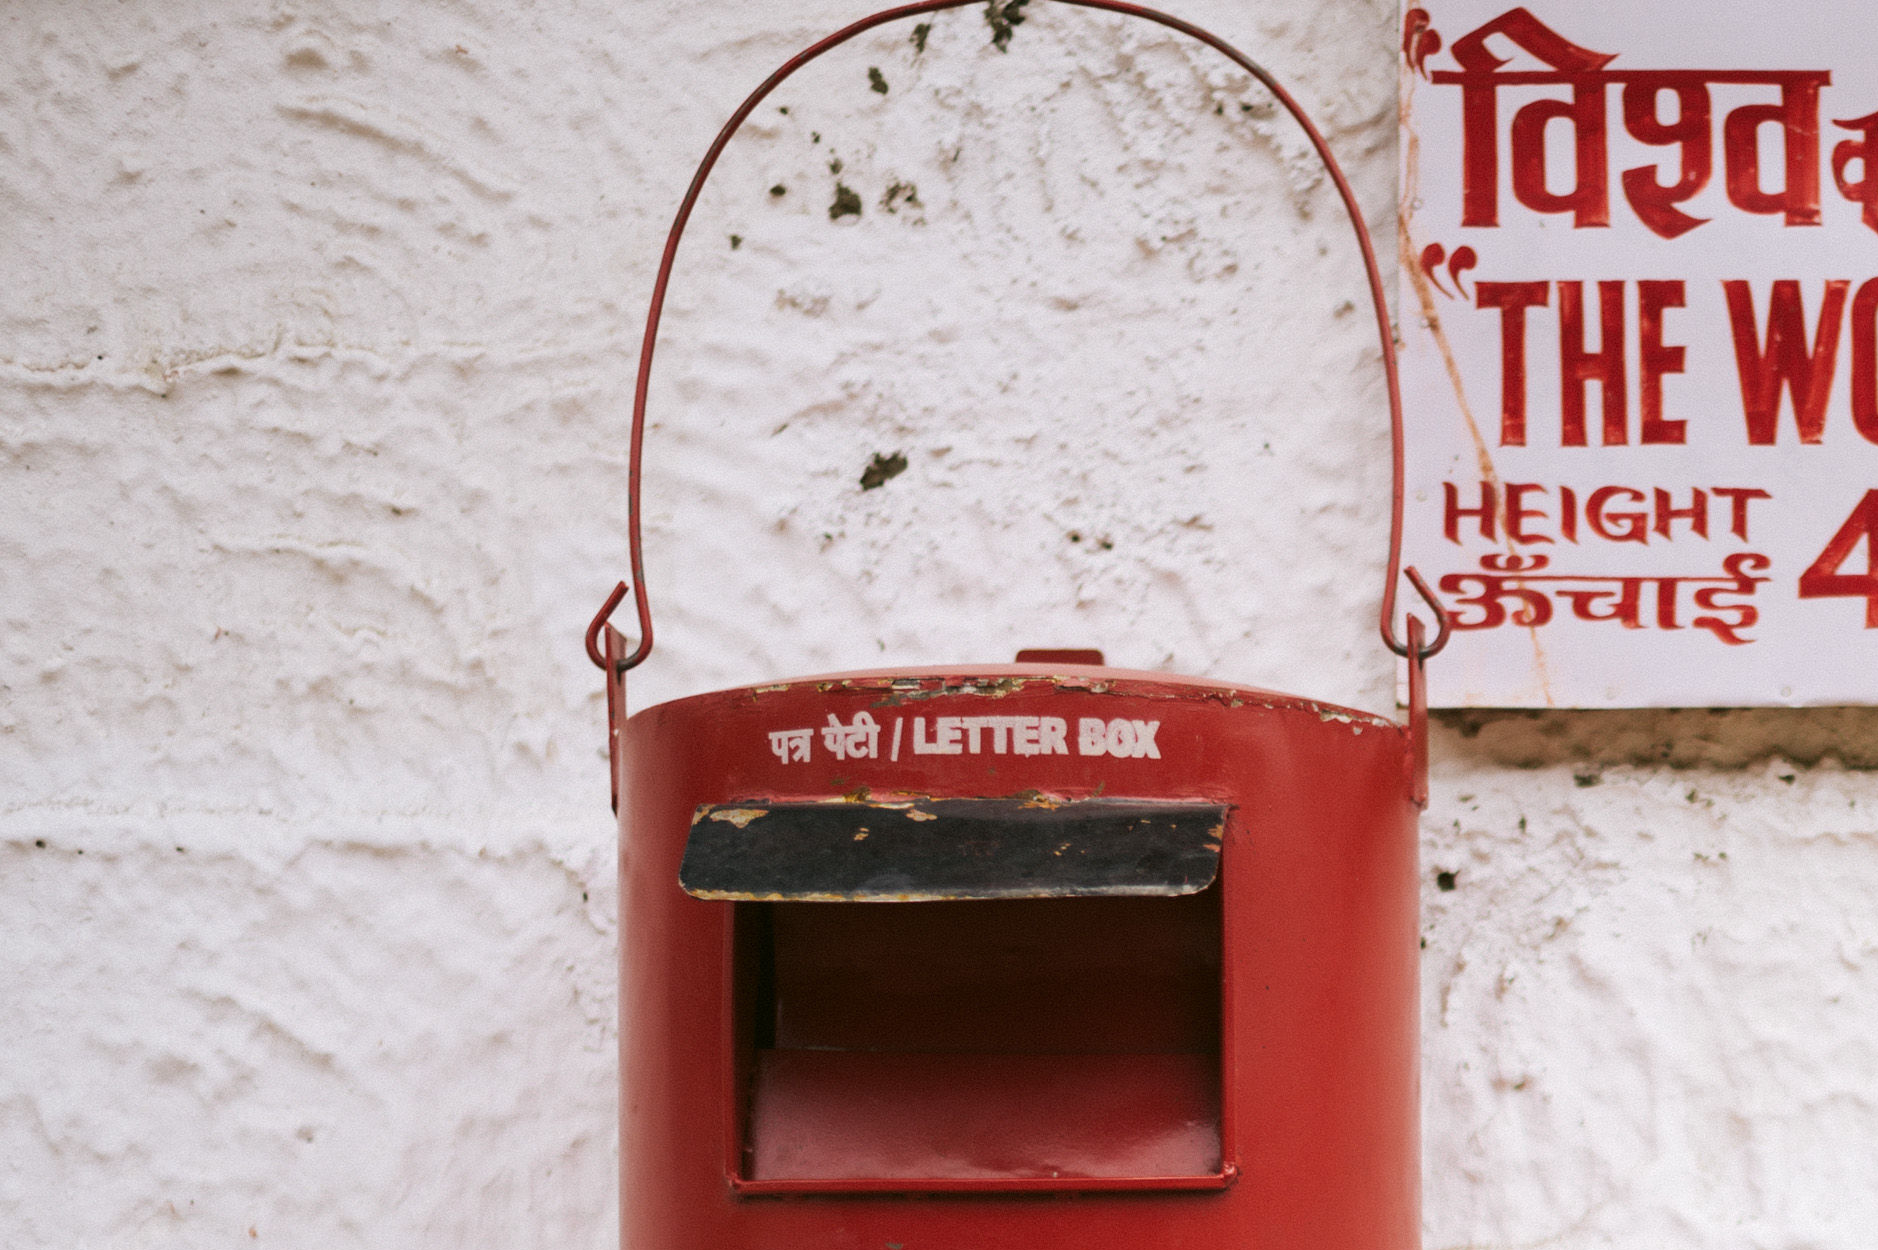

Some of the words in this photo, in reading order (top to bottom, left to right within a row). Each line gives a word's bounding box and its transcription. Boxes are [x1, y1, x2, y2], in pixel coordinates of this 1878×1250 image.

[1441, 479, 1772, 547] HEIGHT
[768, 727, 814, 765] पत्र
[912, 714, 1070, 758] LETTER
[1077, 716, 1163, 760] BOX
